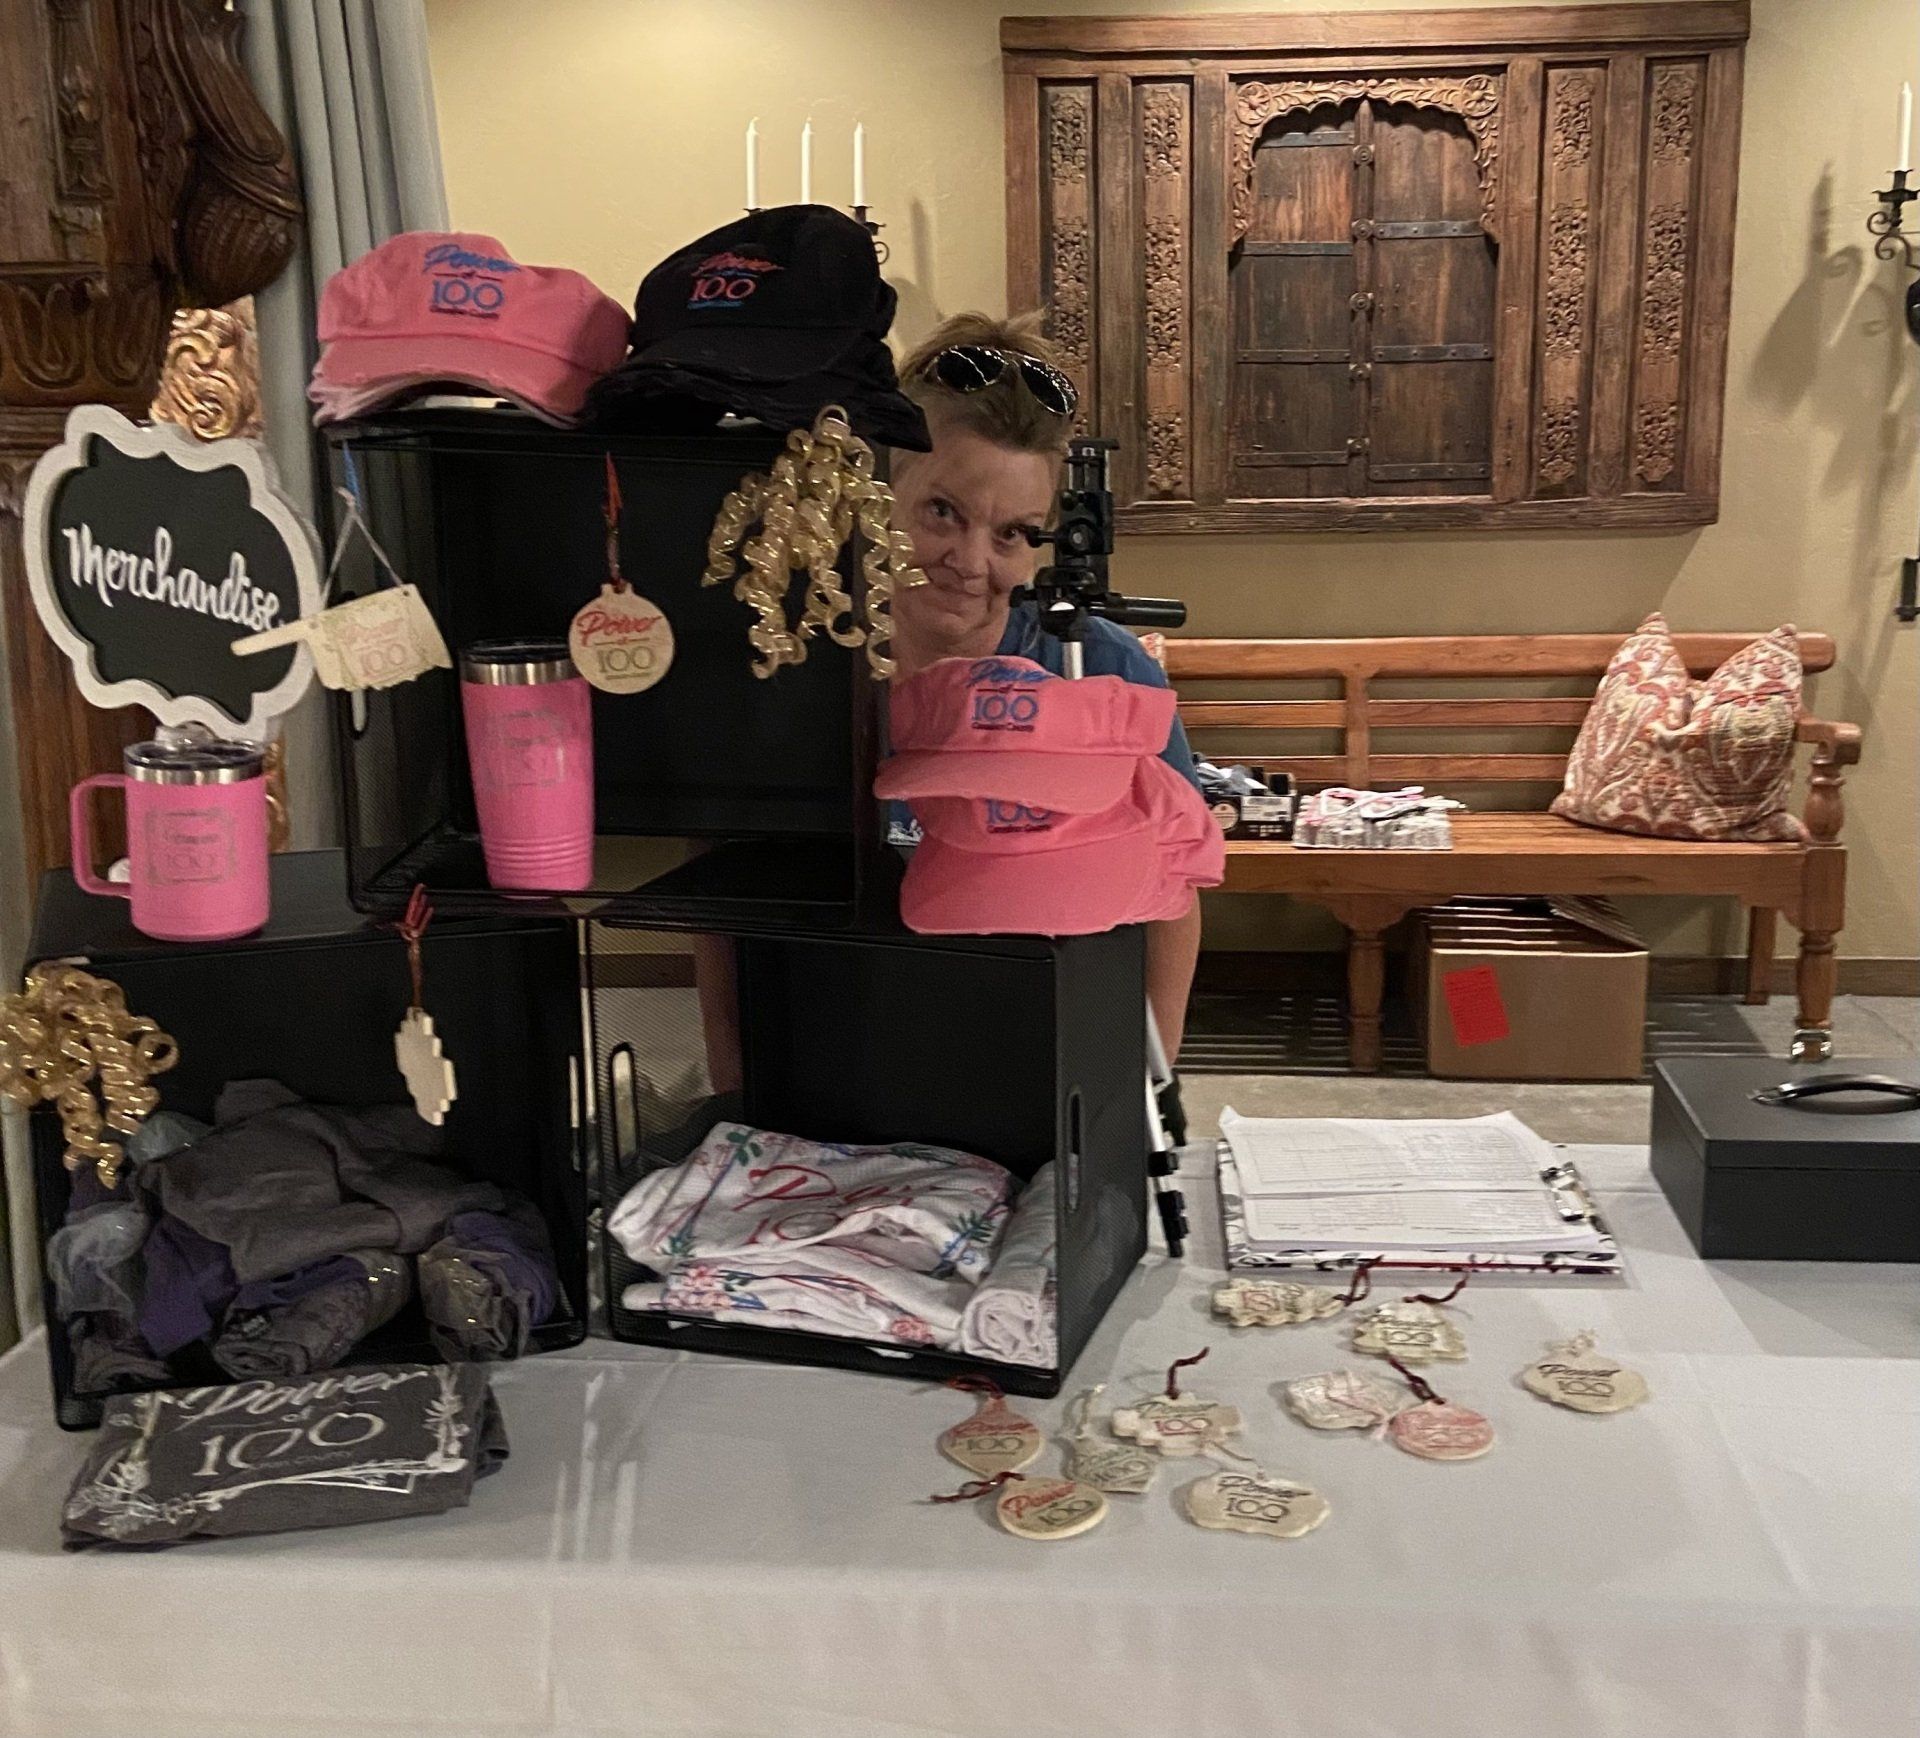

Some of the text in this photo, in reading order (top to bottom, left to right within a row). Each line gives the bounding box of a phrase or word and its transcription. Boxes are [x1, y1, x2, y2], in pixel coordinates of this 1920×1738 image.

[432, 279, 504, 311] 100
[690, 276, 756, 301] 100
[62, 523, 287, 631] Merchandise
[597, 645, 657, 673] 100
[973, 694, 1039, 722] 100
[1558, 1380, 1615, 1395] 100
[192, 1412, 387, 1476] 100
[1038, 1499, 1093, 1526] 100
[1224, 1497, 1290, 1519] 100
